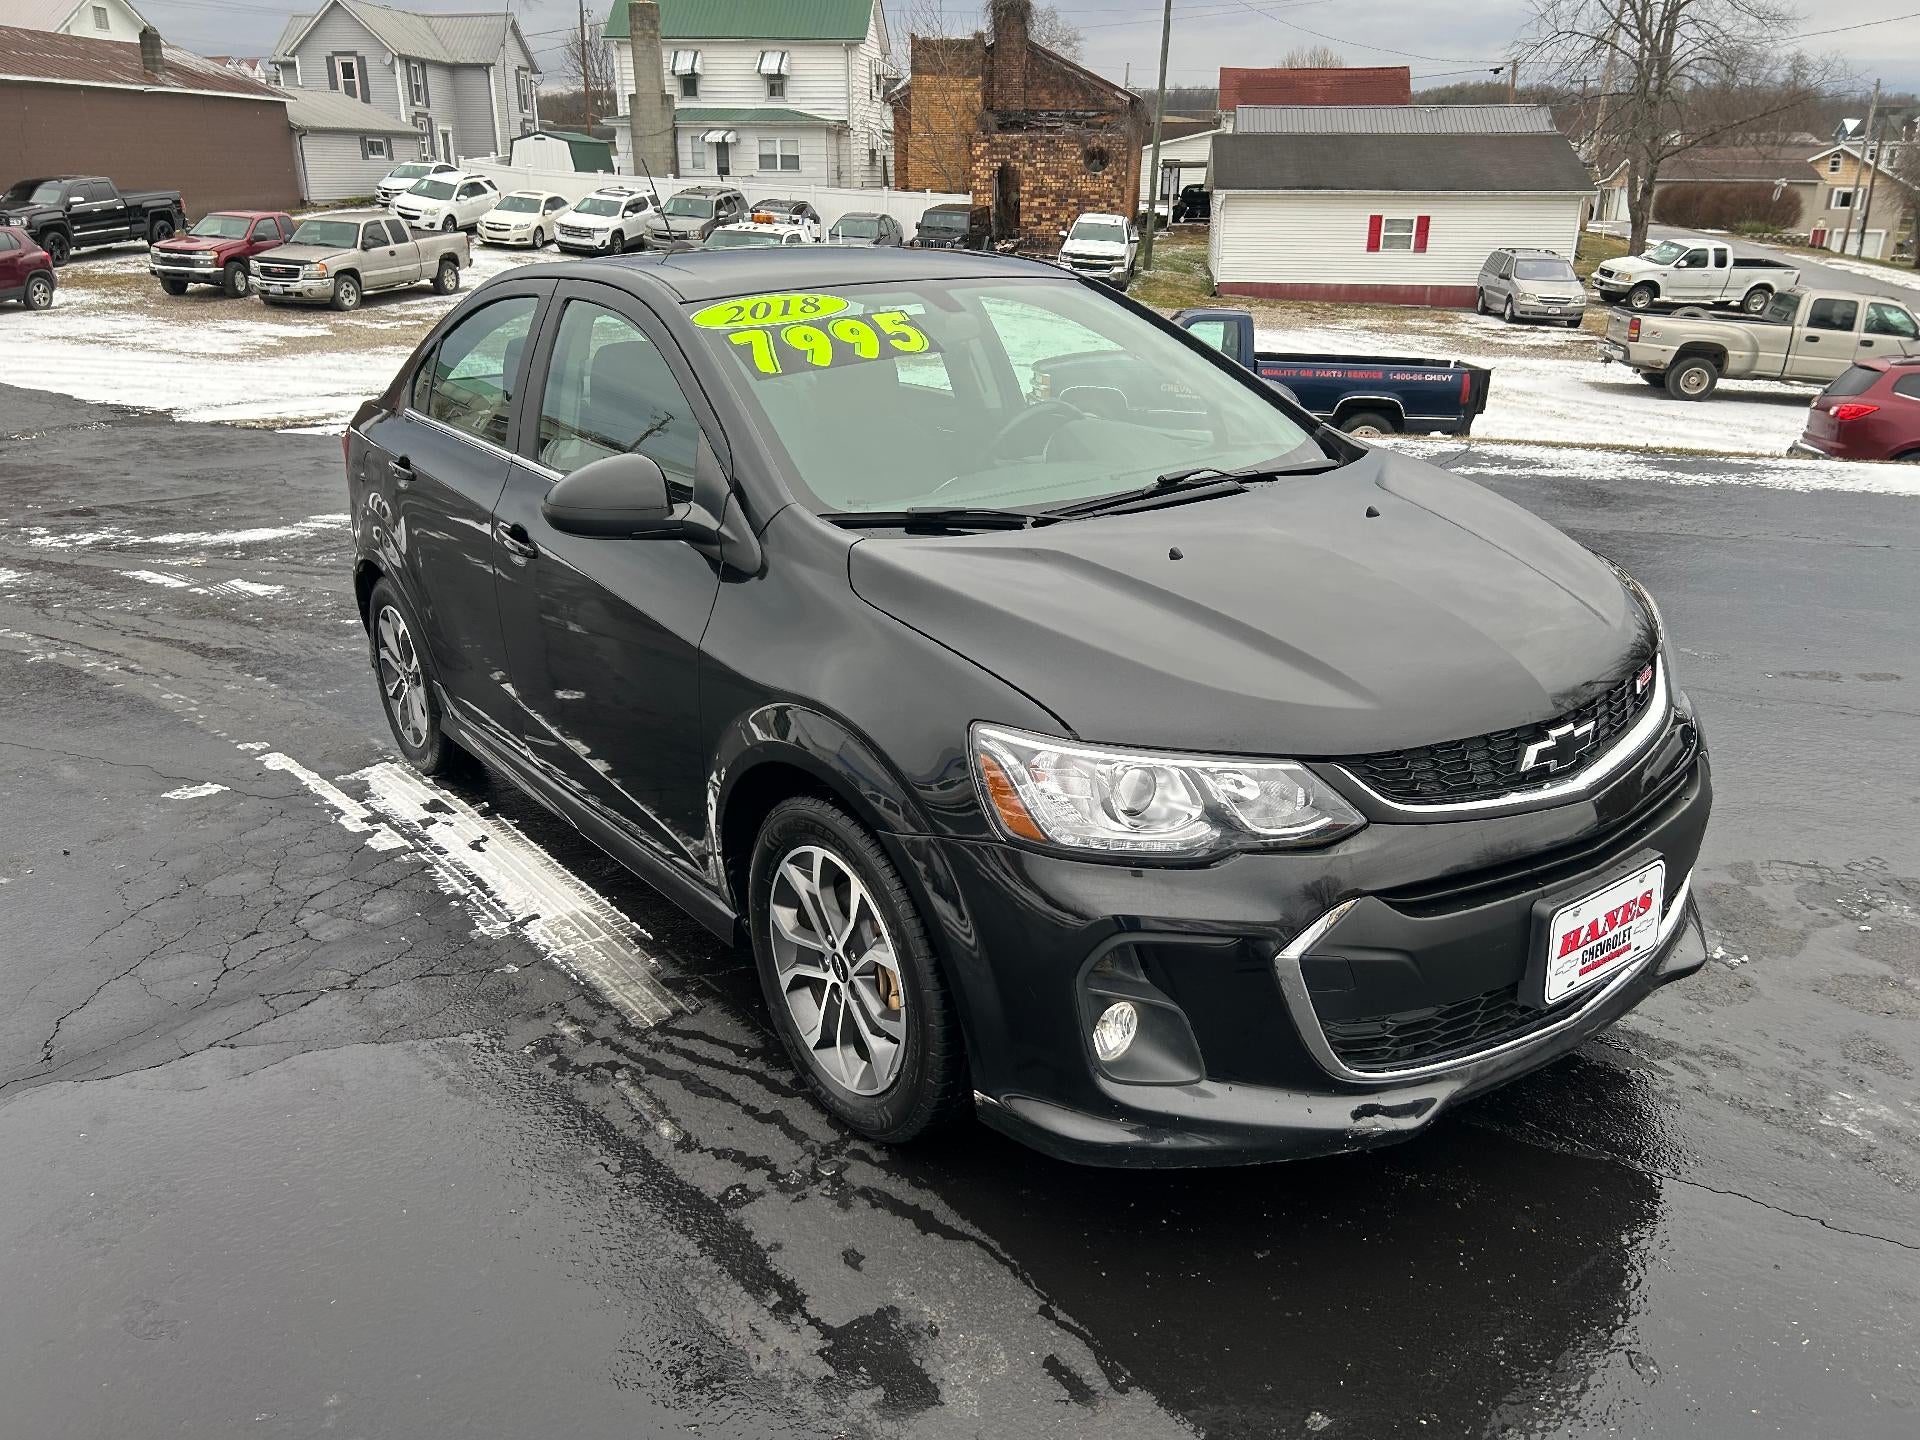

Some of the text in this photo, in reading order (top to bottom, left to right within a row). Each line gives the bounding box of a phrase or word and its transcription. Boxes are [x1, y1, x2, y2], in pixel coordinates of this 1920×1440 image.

[726, 297, 820, 324] 2018
[728, 310, 930, 375] 7995
[1261, 368, 1297, 377] QUALITY
[1557, 888, 1654, 960] HANES
[1581, 926, 1633, 966] CHEVROLET
